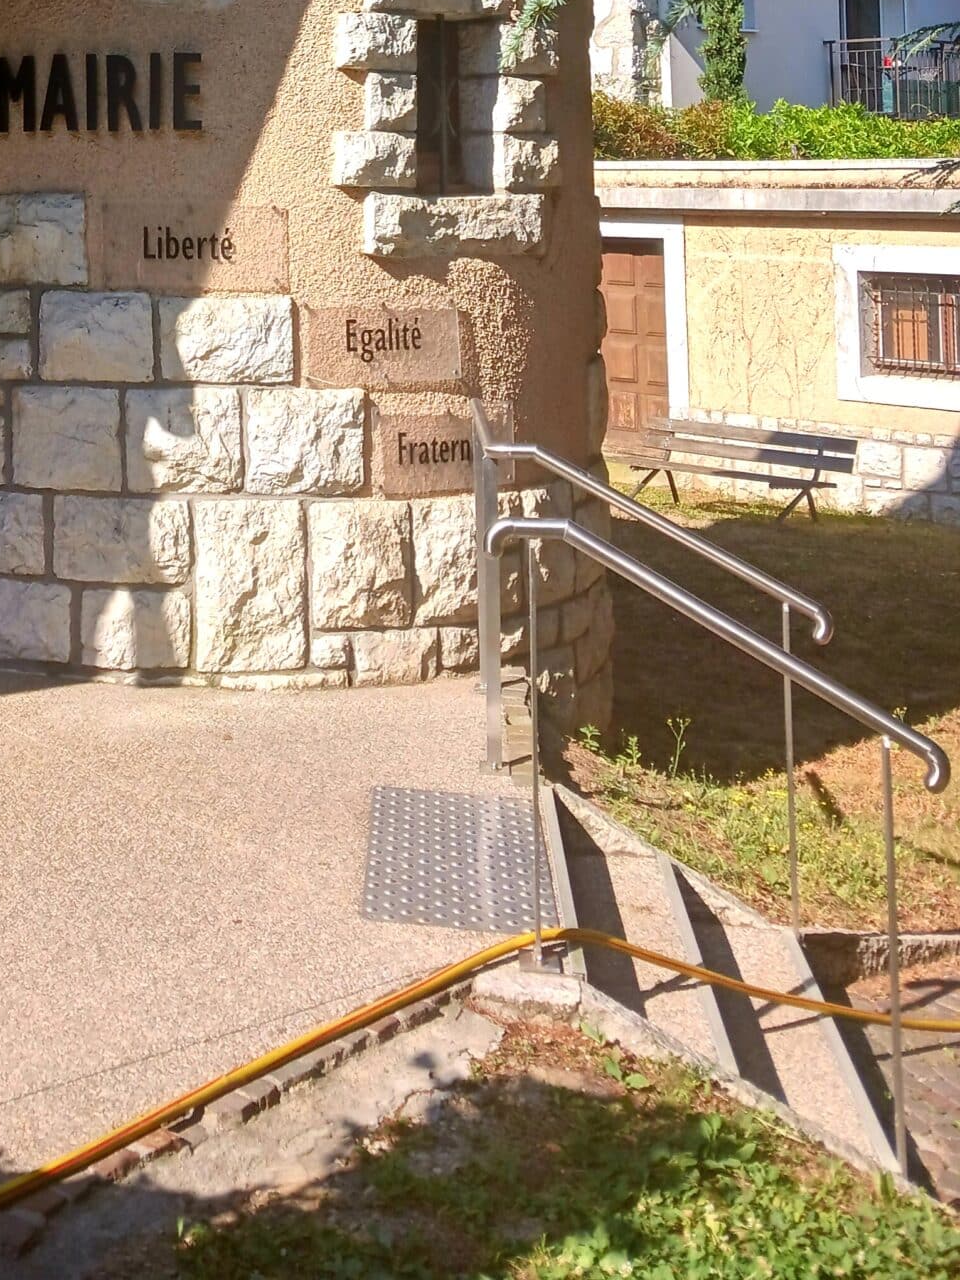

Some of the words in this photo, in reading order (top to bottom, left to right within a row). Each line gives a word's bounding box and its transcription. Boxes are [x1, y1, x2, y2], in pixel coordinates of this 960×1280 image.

[143, 226, 234, 260] Liberté
[345, 317, 422, 363] Egalité
[397, 432, 471, 465] Fratern
